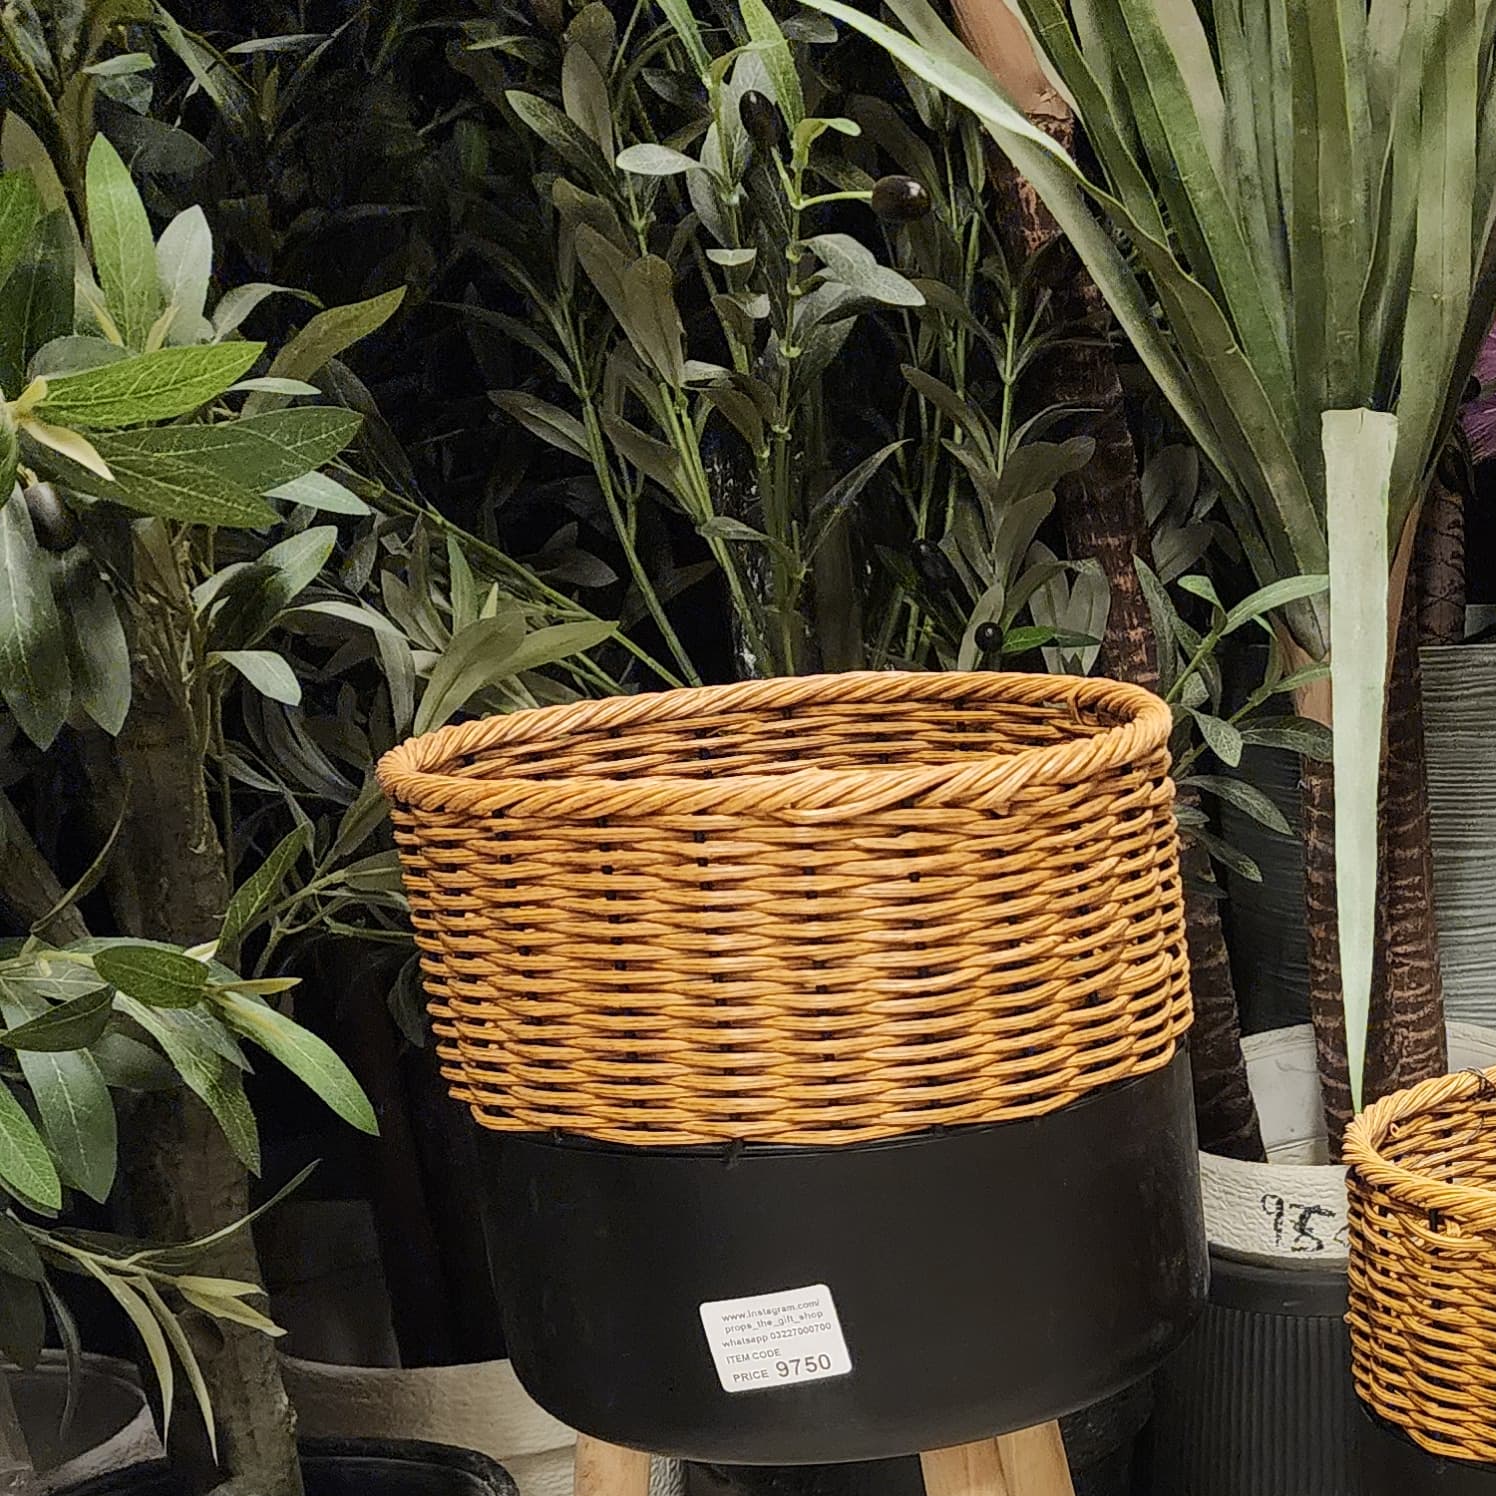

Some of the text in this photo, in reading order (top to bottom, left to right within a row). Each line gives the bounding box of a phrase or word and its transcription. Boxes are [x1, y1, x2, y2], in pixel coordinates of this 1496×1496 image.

[725, 1310, 823, 1334] props_the_gift_shop
[722, 1334, 768, 1348] whatsapp
[726, 1348, 782, 1364] ITEM CODE
[733, 1353, 832, 1382] PRICE 9750
